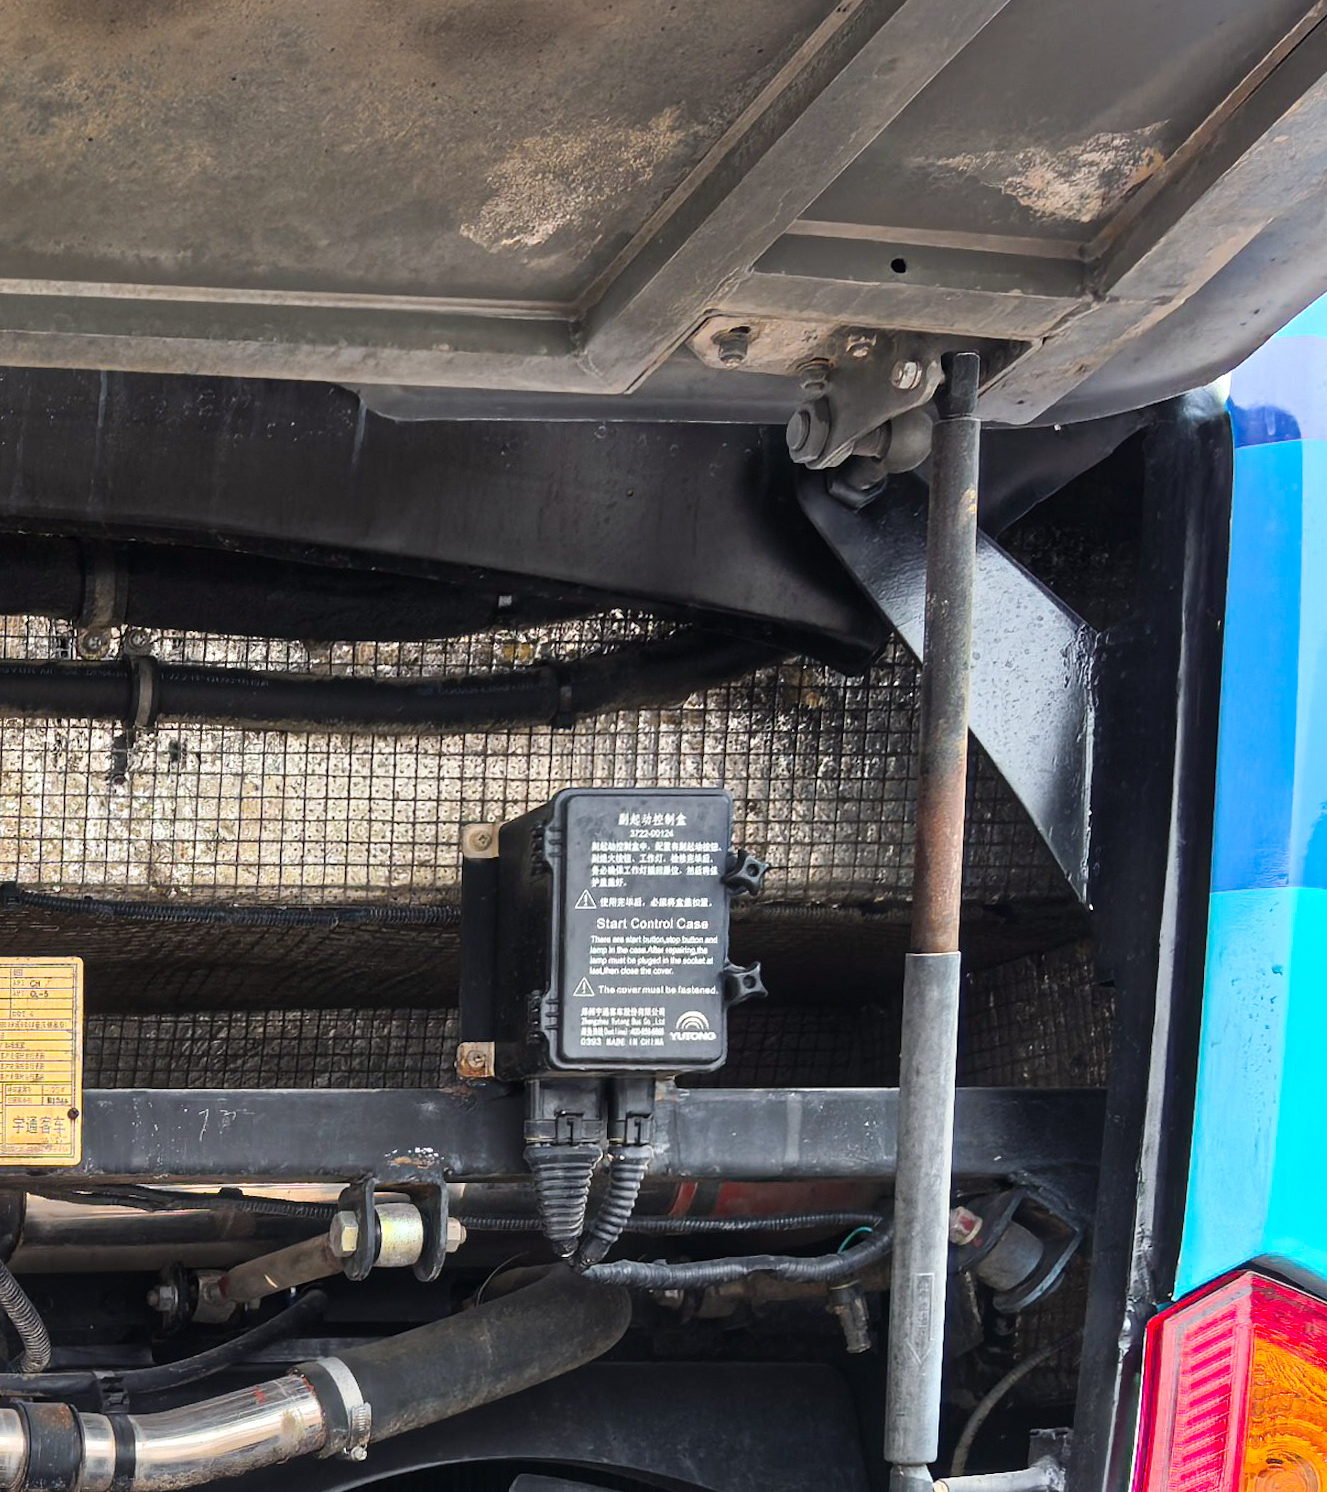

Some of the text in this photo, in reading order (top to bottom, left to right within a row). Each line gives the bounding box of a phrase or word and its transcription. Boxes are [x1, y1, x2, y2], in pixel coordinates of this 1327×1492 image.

[596, 917, 709, 930] Start Control Case
[590, 935, 611, 944] There
[626, 935, 642, 944] start
[682, 935, 704, 944] button
[704, 935, 718, 944] and
[589, 946, 608, 957] lamp
[609, 946, 616, 955] in
[617, 946, 628, 955] the
[589, 956, 608, 967] lamp
[608, 957, 626, 965] must
[628, 956, 637, 965] be
[663, 956, 669, 965] in
[670, 956, 682, 965] the
[620, 966, 639, 975] close
[640, 966, 652, 975] the
[653, 967, 674, 975] cover.
[598, 985, 719, 995] The cover must be fastened.
[669, 1032, 717, 1041] YUTONG
[606, 1038, 626, 1046] MADE
[629, 1038, 638, 1046] IN
[640, 1038, 665, 1046] CHINA
[12, 1115, 66, 1135] 宇通客车
